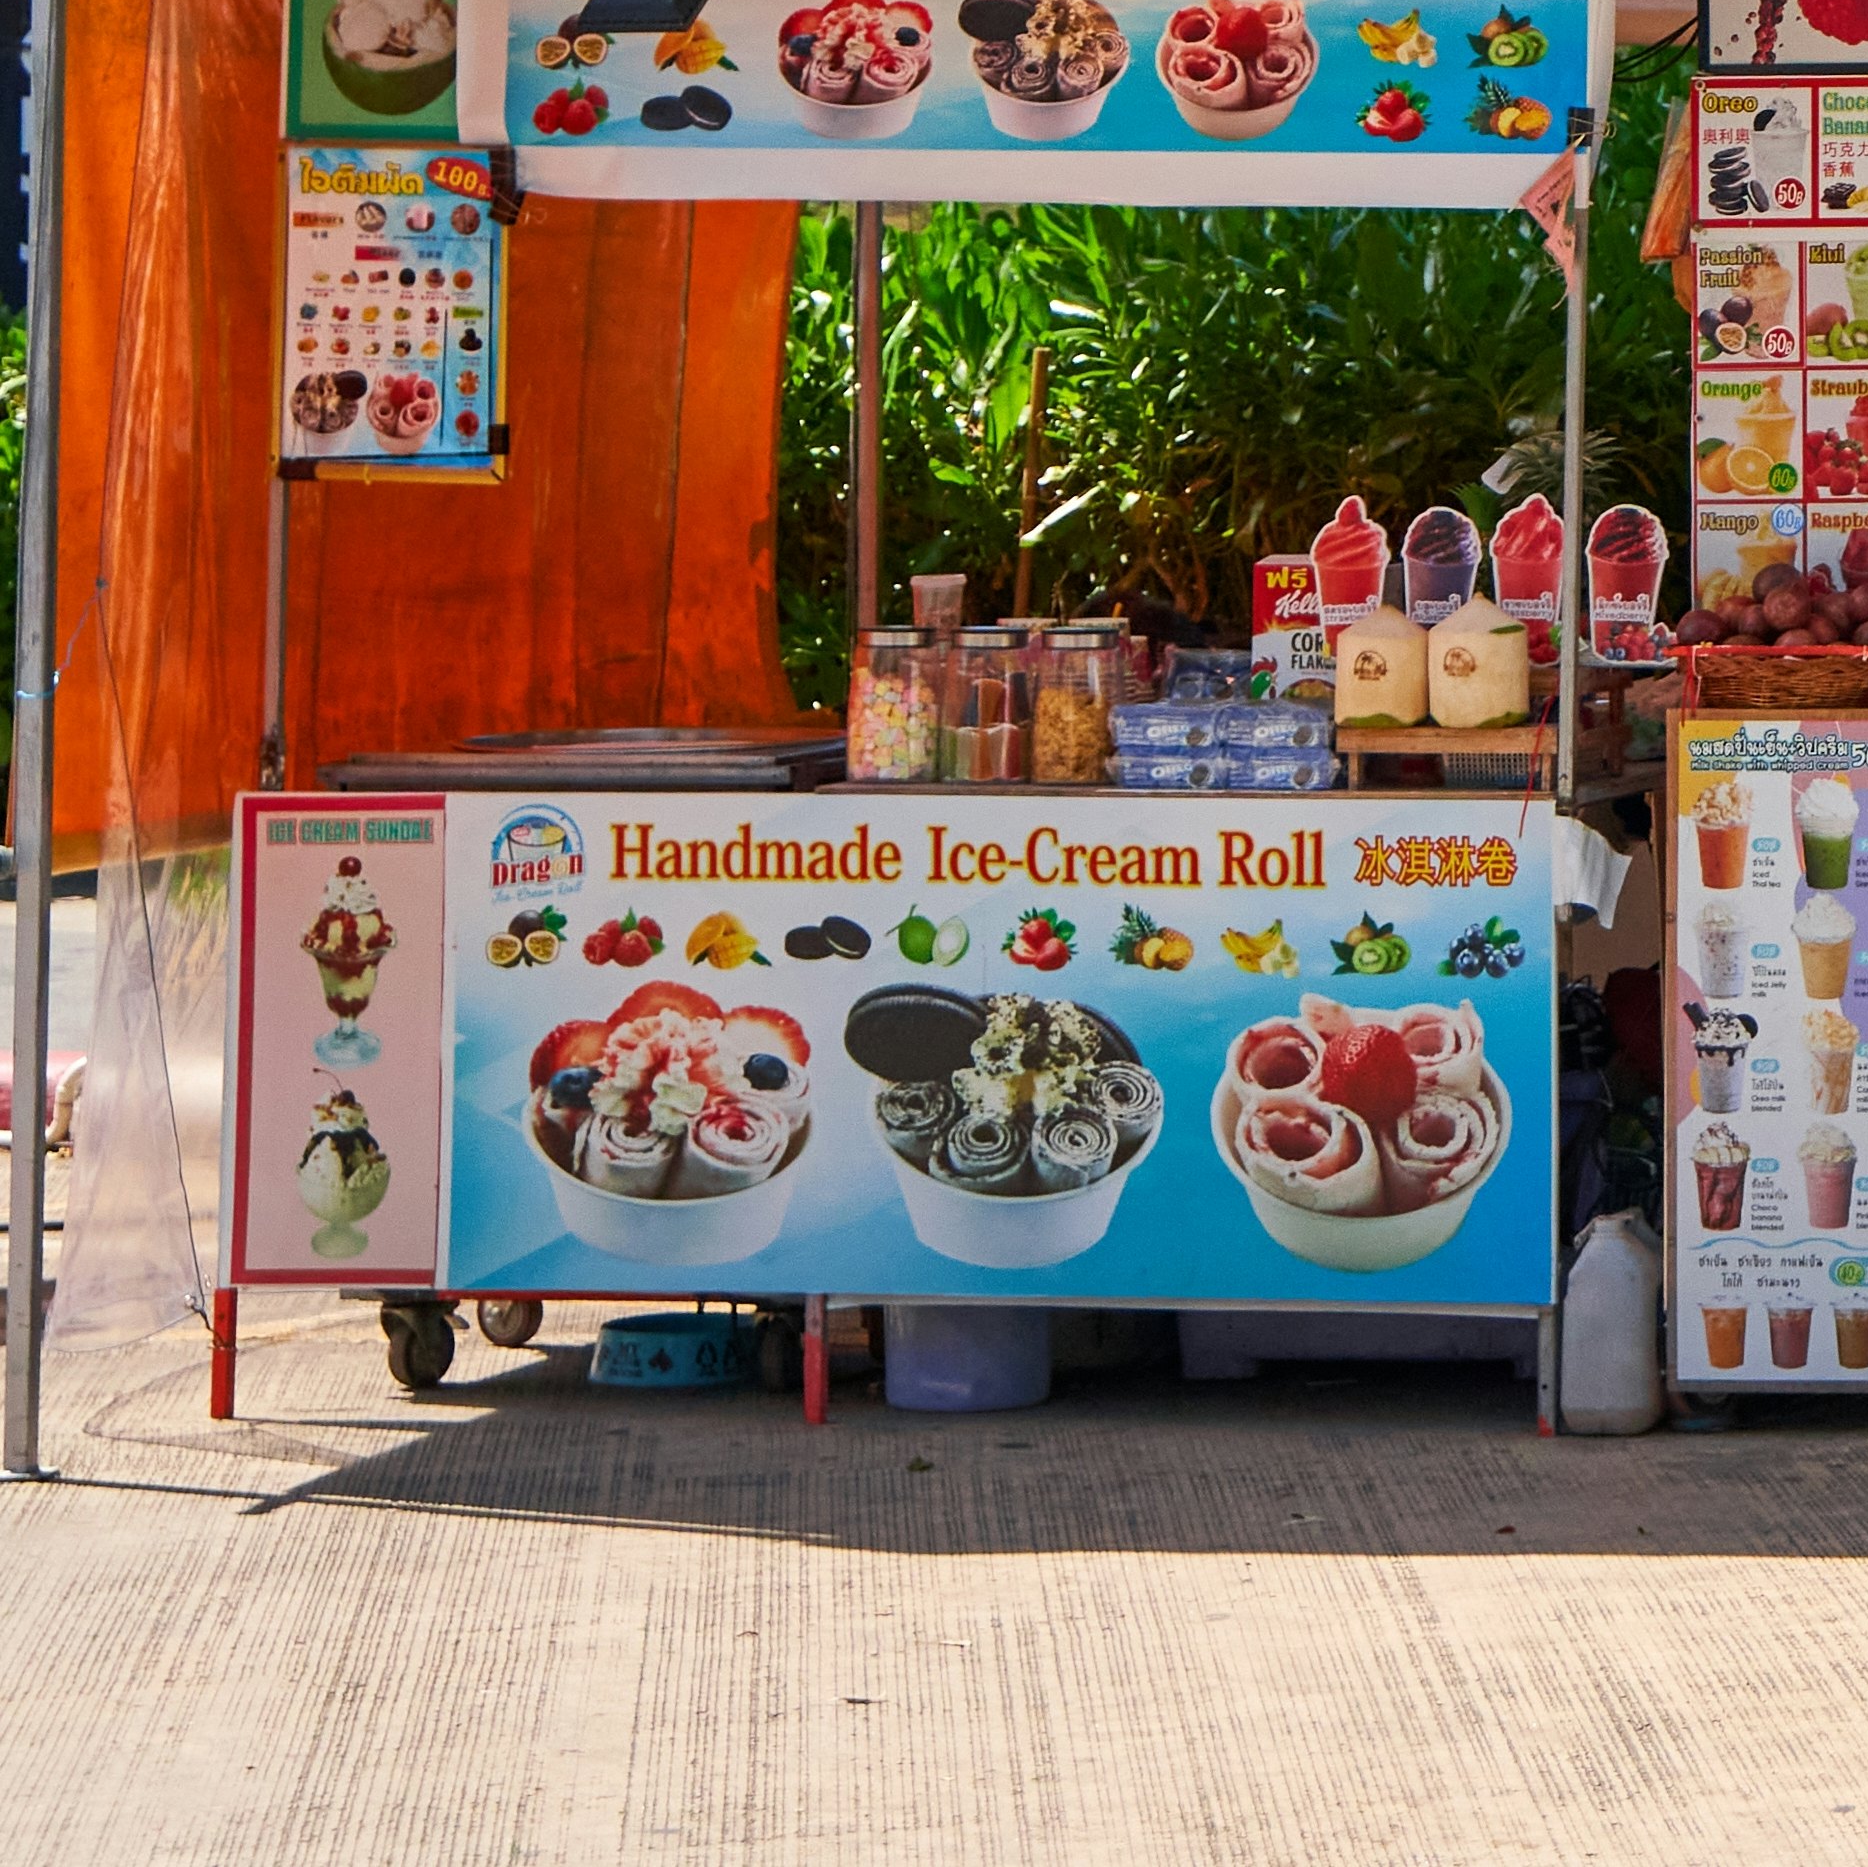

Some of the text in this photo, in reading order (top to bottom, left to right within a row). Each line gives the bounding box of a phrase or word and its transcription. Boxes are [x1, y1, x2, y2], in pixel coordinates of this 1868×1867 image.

[1702, 93, 1758, 113] Oreo
[1702, 128, 1750, 145] 奥利奥
[1823, 162, 1854, 178] 香蕉
[1700, 248, 1762, 266] Passion
[1809, 244, 1845, 263] Kiwi
[1700, 269, 1739, 288] Fruit
[1701, 381, 1762, 400] Orange
[1700, 512, 1759, 534] Mango
[1266, 567, 1307, 589] ฟรี
[267, 818, 433, 844] ICE CREAM SUNDAE
[609, 823, 1326, 888] Handmade Ice-Cream Roll
[1355, 835, 1518, 887] 冰淇淋卷
[491, 854, 584, 887] Dragon
